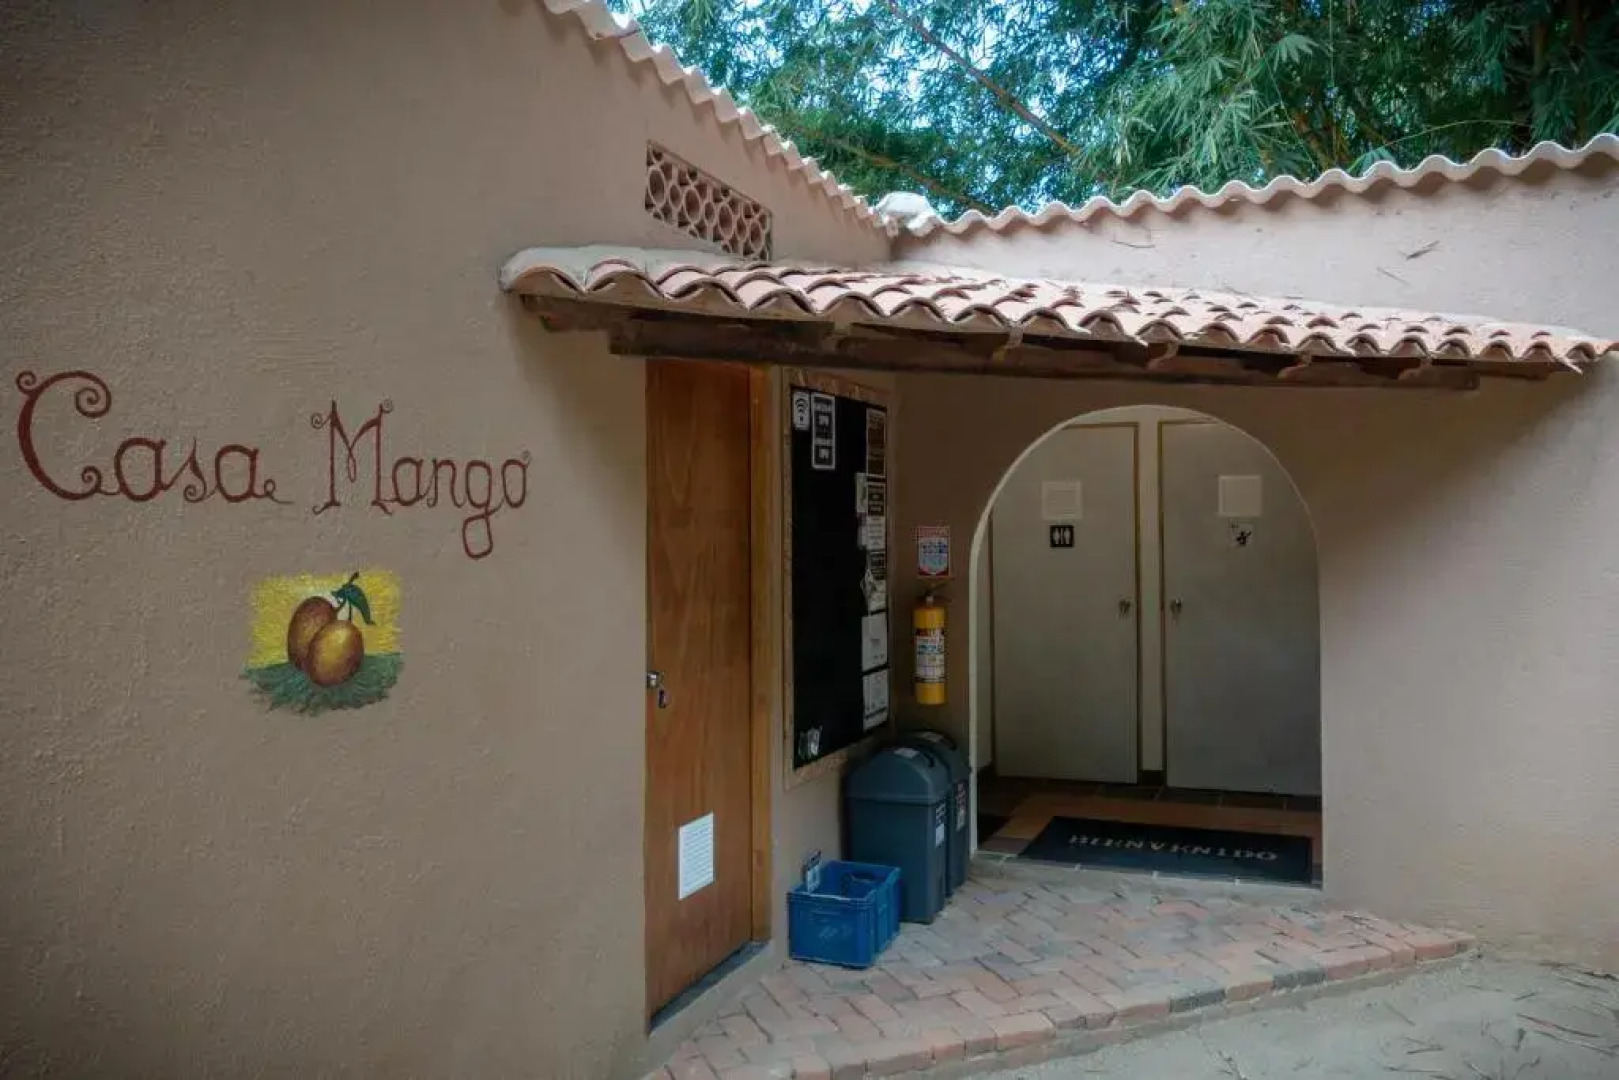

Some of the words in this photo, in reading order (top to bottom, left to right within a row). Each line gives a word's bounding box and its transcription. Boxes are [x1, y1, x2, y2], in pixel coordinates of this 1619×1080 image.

[16, 369, 293, 503] Casa
[310, 400, 532, 560] Mango
[1068, 834, 1279, 862] BIENVENIDO
